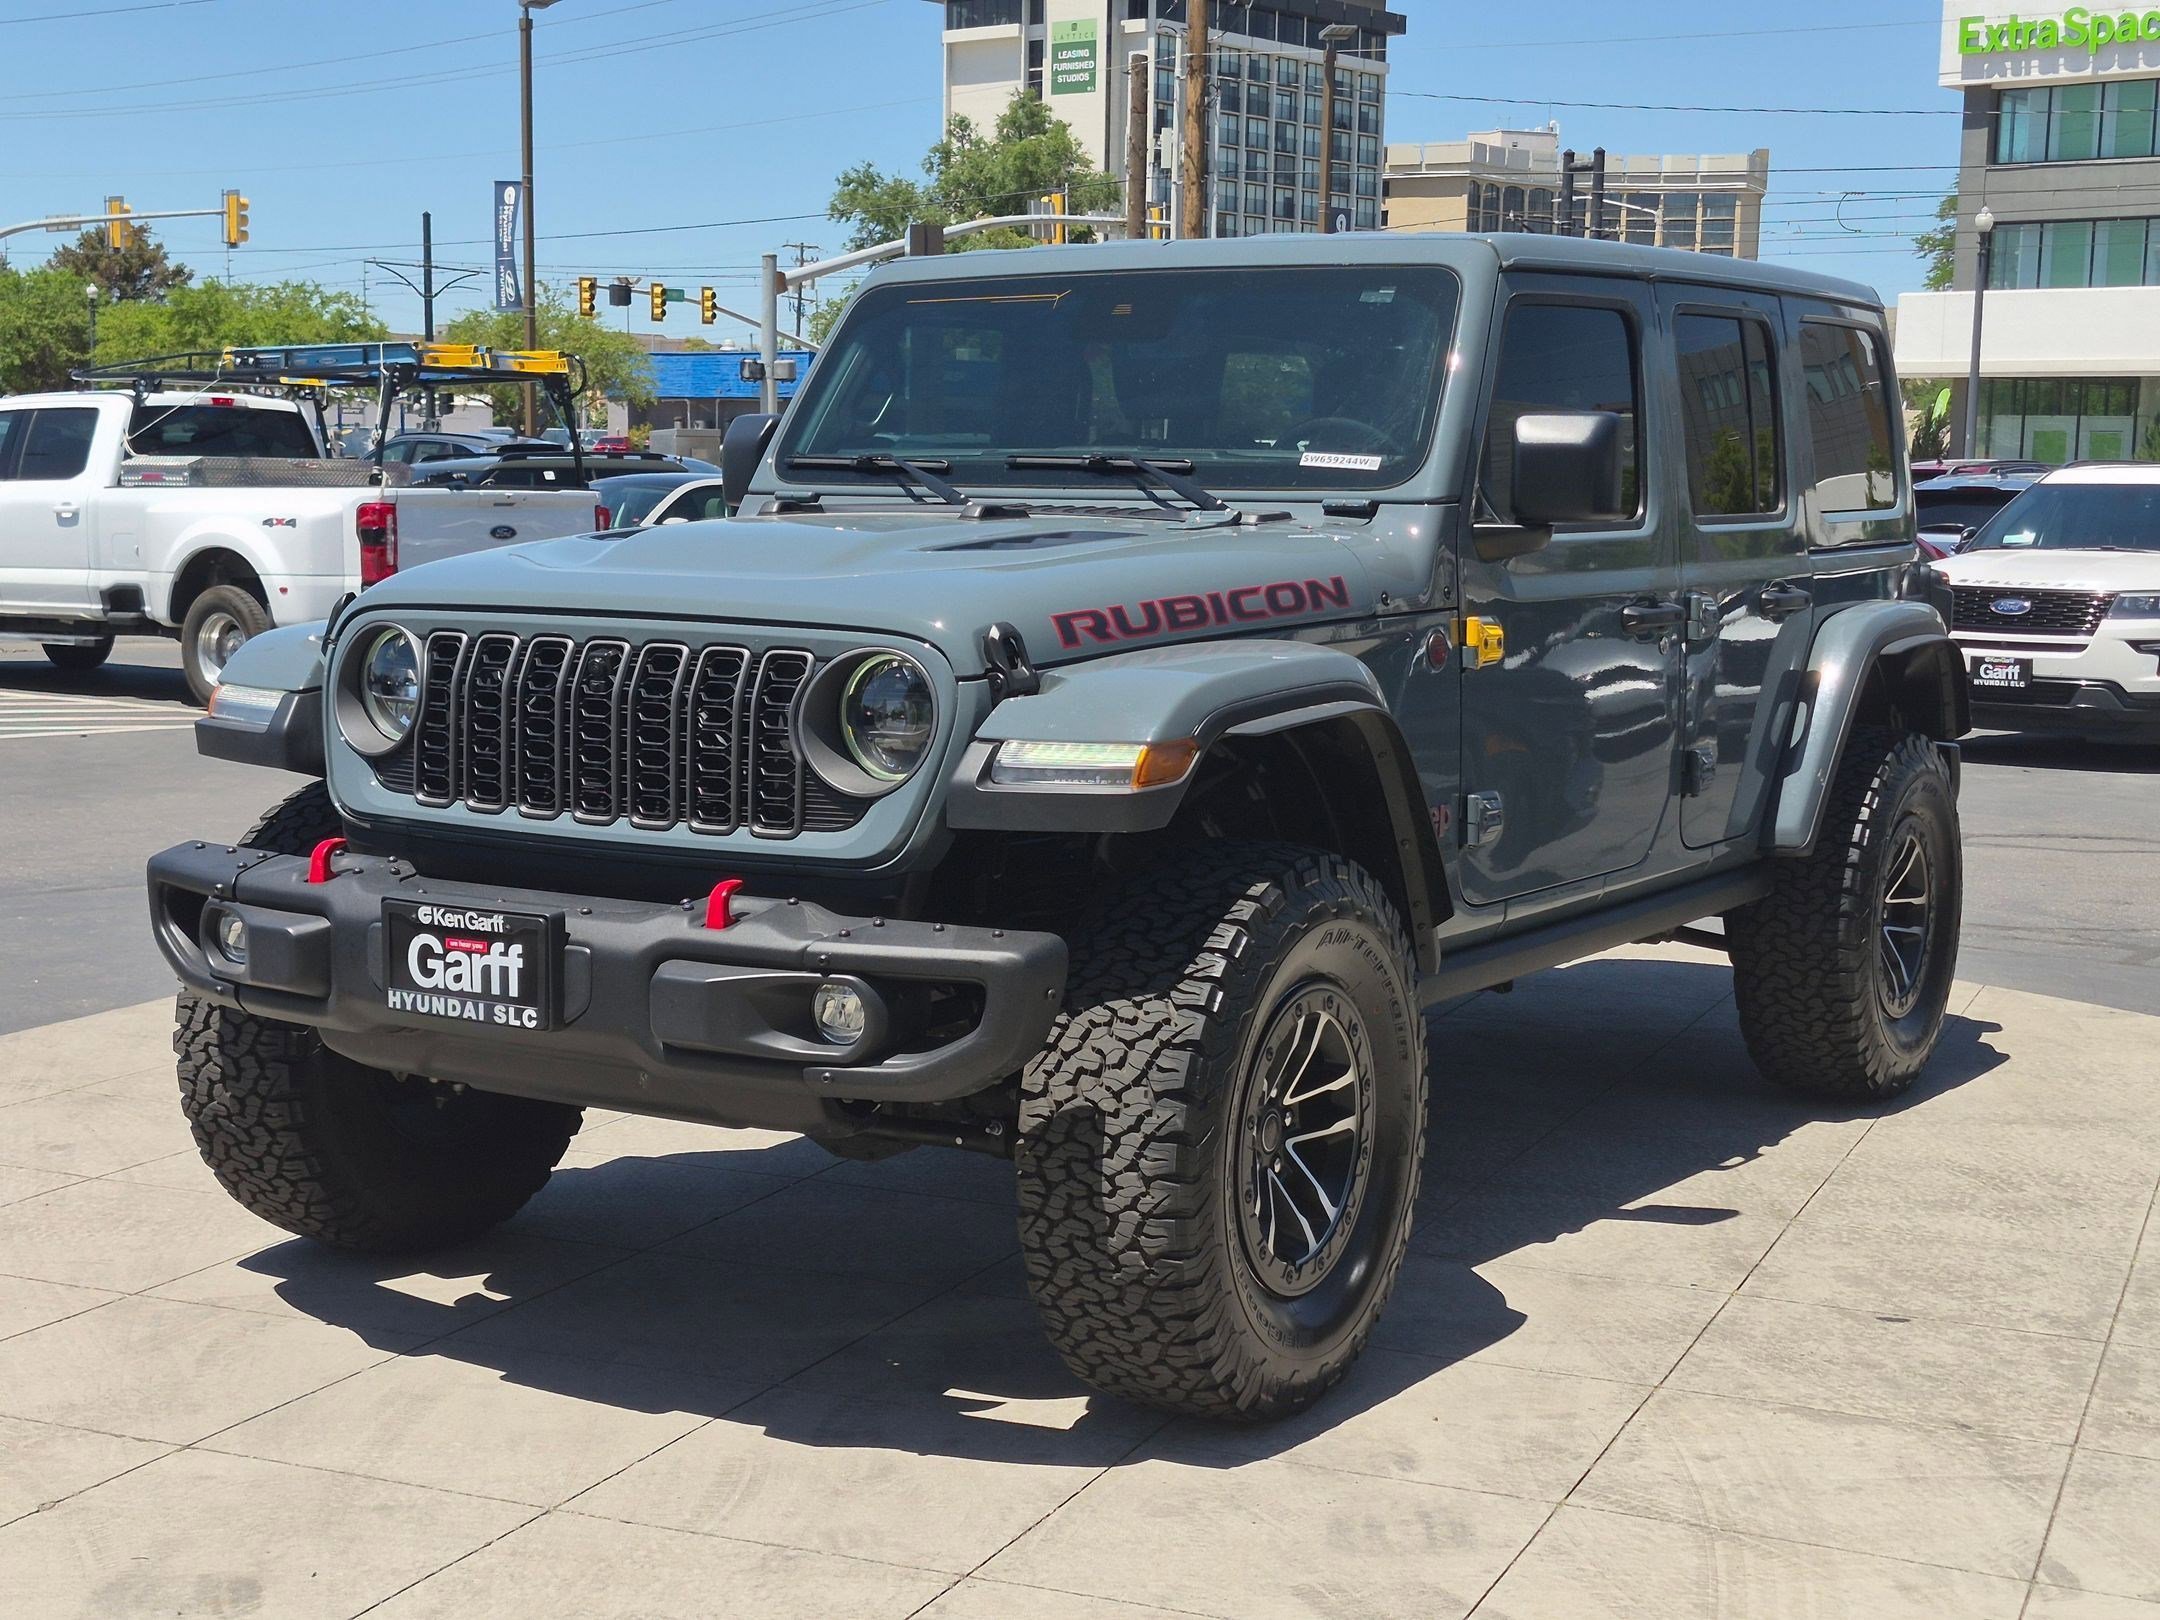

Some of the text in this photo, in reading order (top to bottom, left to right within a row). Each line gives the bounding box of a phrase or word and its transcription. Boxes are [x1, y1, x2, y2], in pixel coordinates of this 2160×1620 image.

[1058, 49, 1090, 59] LEASING
[1052, 60, 1095, 72] FURNISHED
[1057, 72, 1090, 83] STUDIOS
[1050, 576, 1352, 649] RUBICON
[1979, 663, 2020, 681] Garff
[1973, 678, 2009, 687] HYUNDAI
[407, 933, 524, 998] Garff
[387, 990, 538, 1029] HYUNDAI SLC
